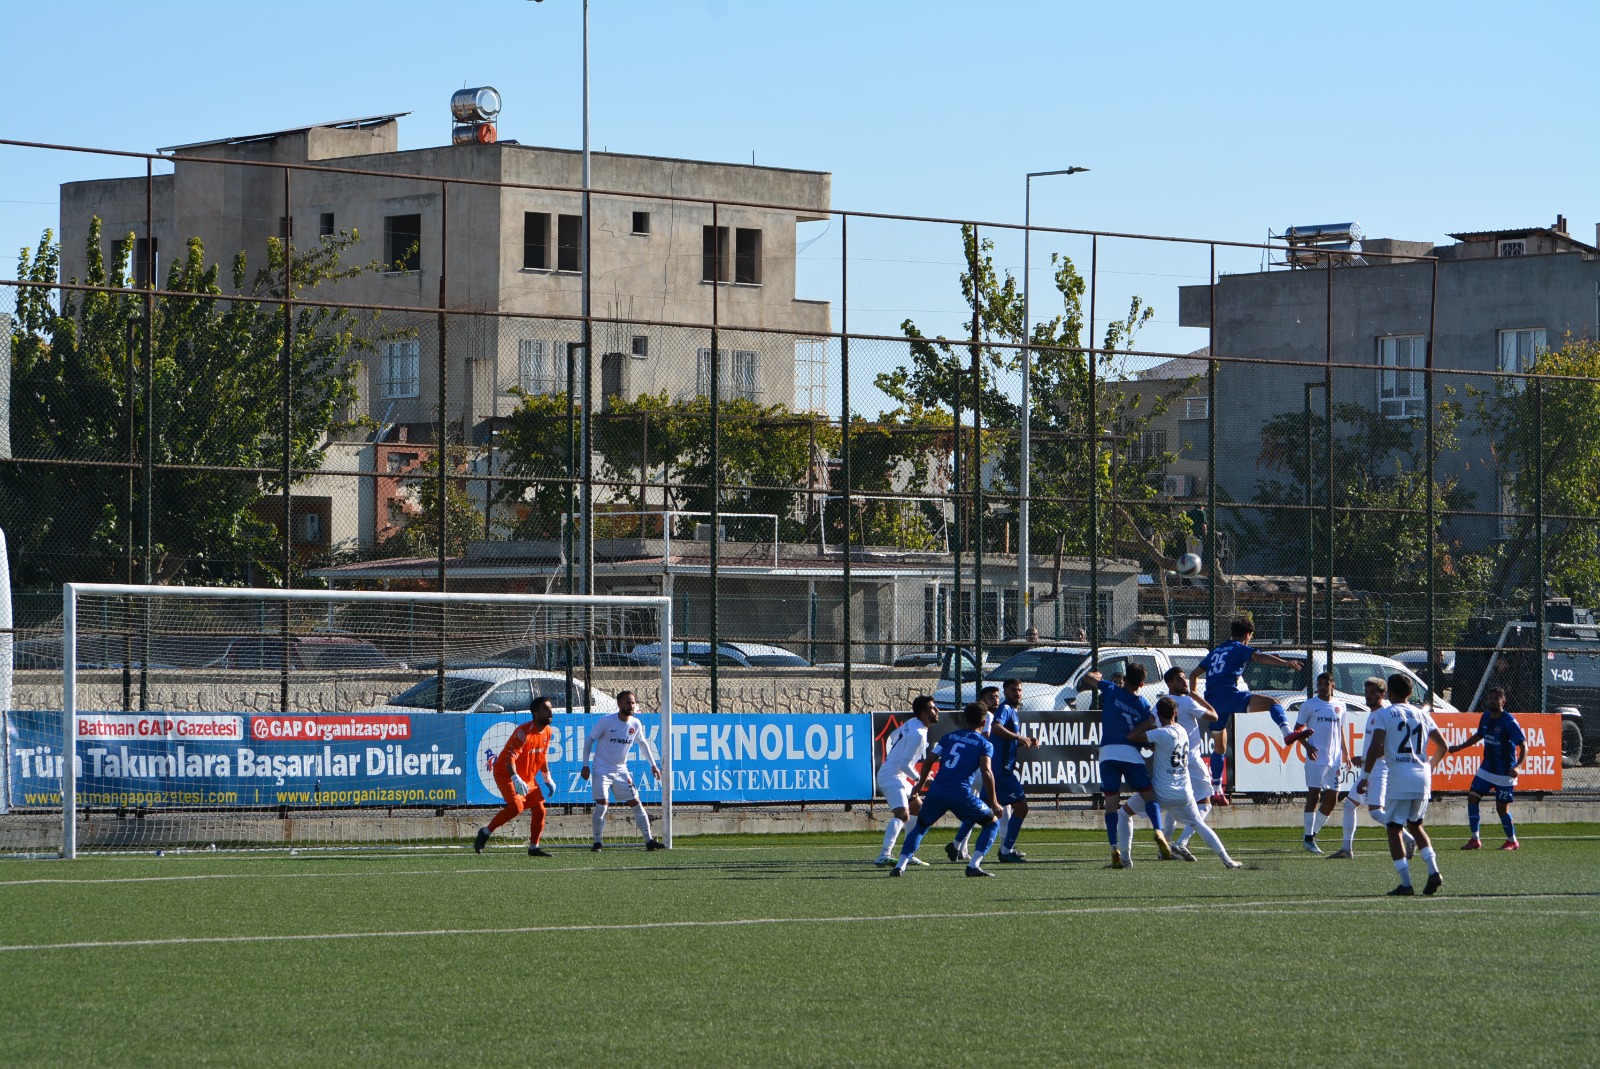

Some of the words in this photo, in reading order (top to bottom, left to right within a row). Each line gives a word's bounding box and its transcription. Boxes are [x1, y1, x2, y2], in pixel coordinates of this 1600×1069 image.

[1208, 651, 1228, 676] 35
[1551, 668, 1574, 682] Y-02
[78, 719, 135, 736] Batman
[138, 720, 174, 736] GAP
[176, 718, 237, 736] Gazetesi
[270, 720, 303, 737] GAP
[305, 718, 408, 741] Organizasyon
[1397, 720, 1423, 755] 21
[671, 724, 855, 761] TEKNOLOJİ
[88, 745, 231, 778] Takımlara
[237, 745, 361, 786] Başarılar
[366, 744, 462, 776] Dileriz.
[944, 742, 966, 769] 5
[702, 764, 830, 791] SİSTEMLERİ
[25, 789, 238, 807] www.atmangapgazetesi.com
[276, 787, 456, 806] www.gaporganizasyon.com
[1499, 790, 1509, 800] 72
